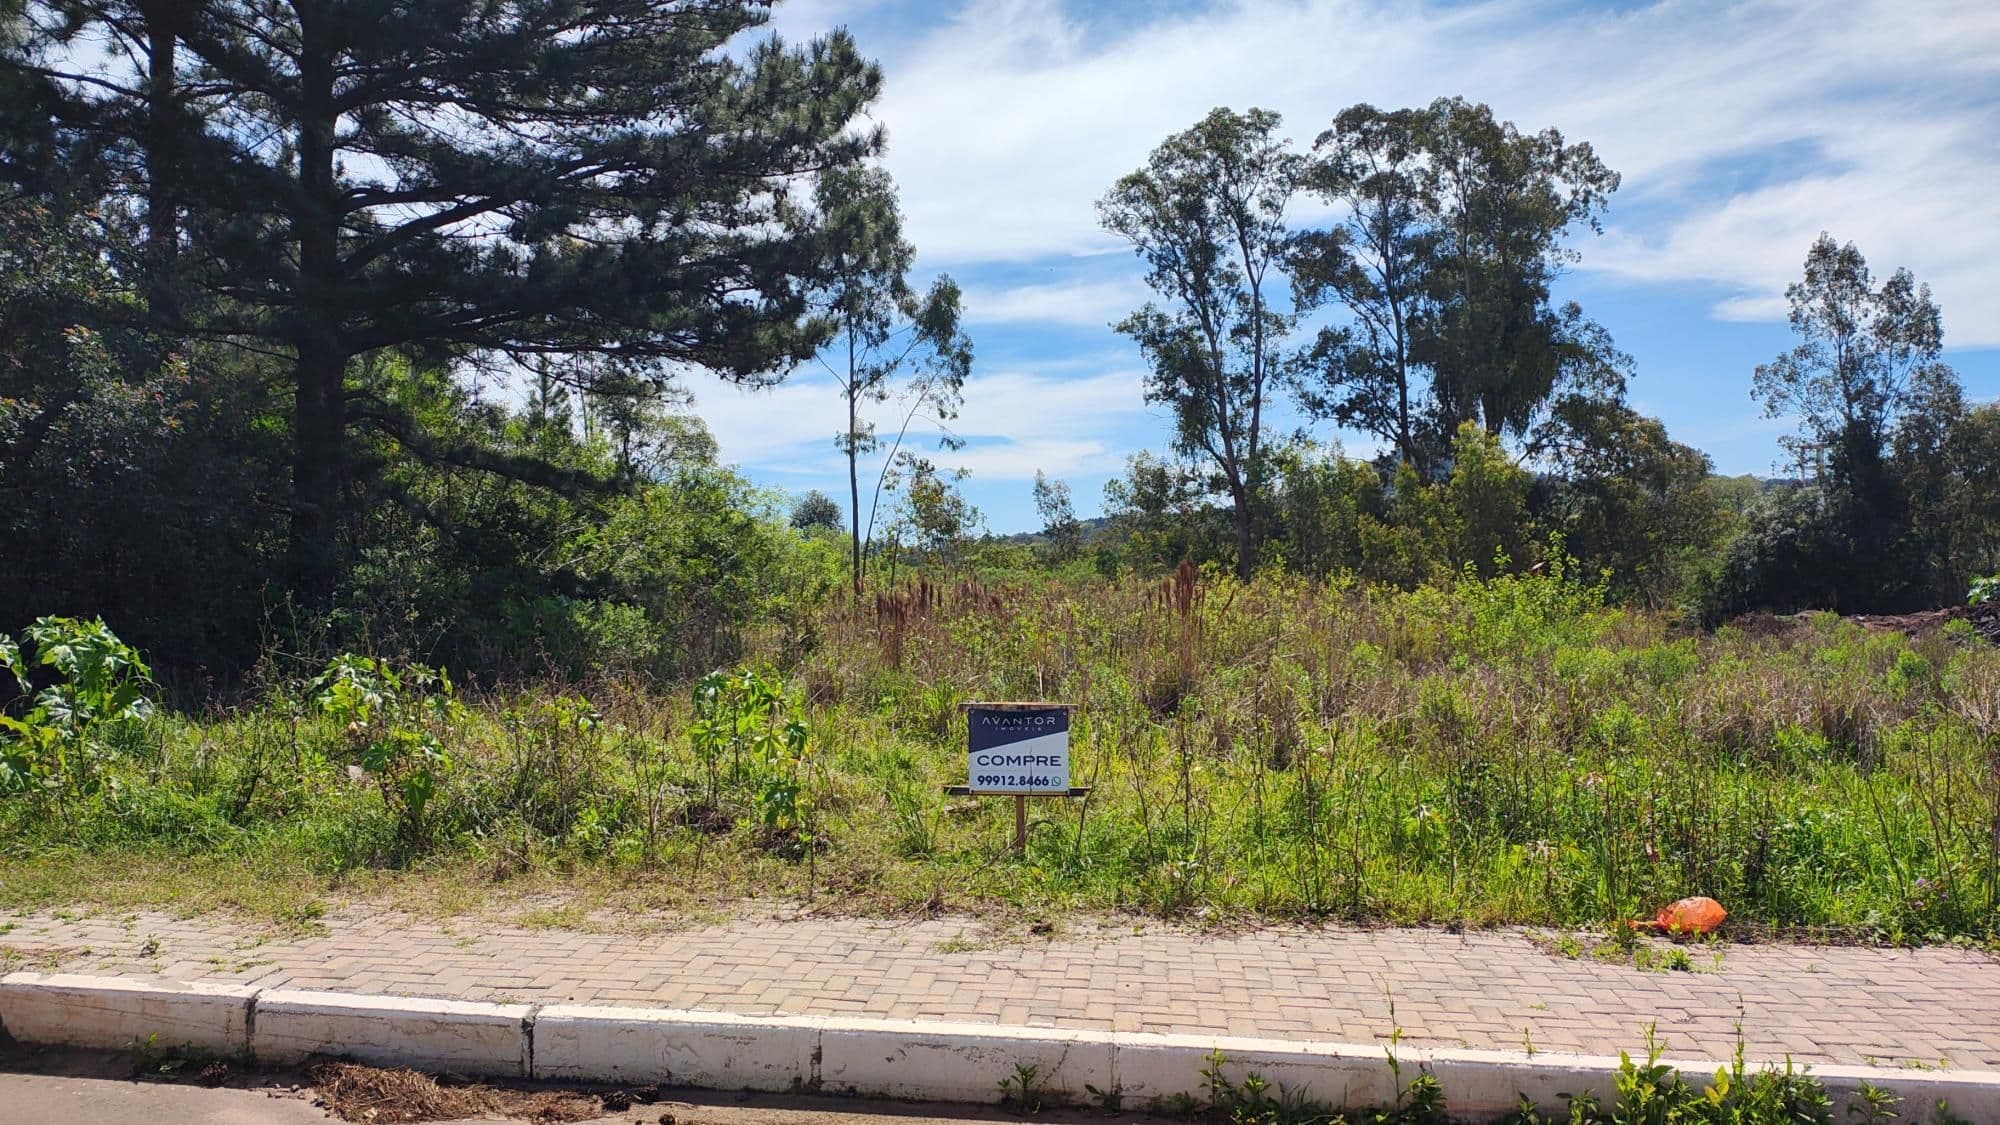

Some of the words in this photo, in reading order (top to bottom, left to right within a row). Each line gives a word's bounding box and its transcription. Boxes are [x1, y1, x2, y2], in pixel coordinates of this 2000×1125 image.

[982, 716, 1056, 725] AVANTOR
[976, 755, 1062, 767] COMPRE
[977, 775, 1049, 786] 99912.8466
